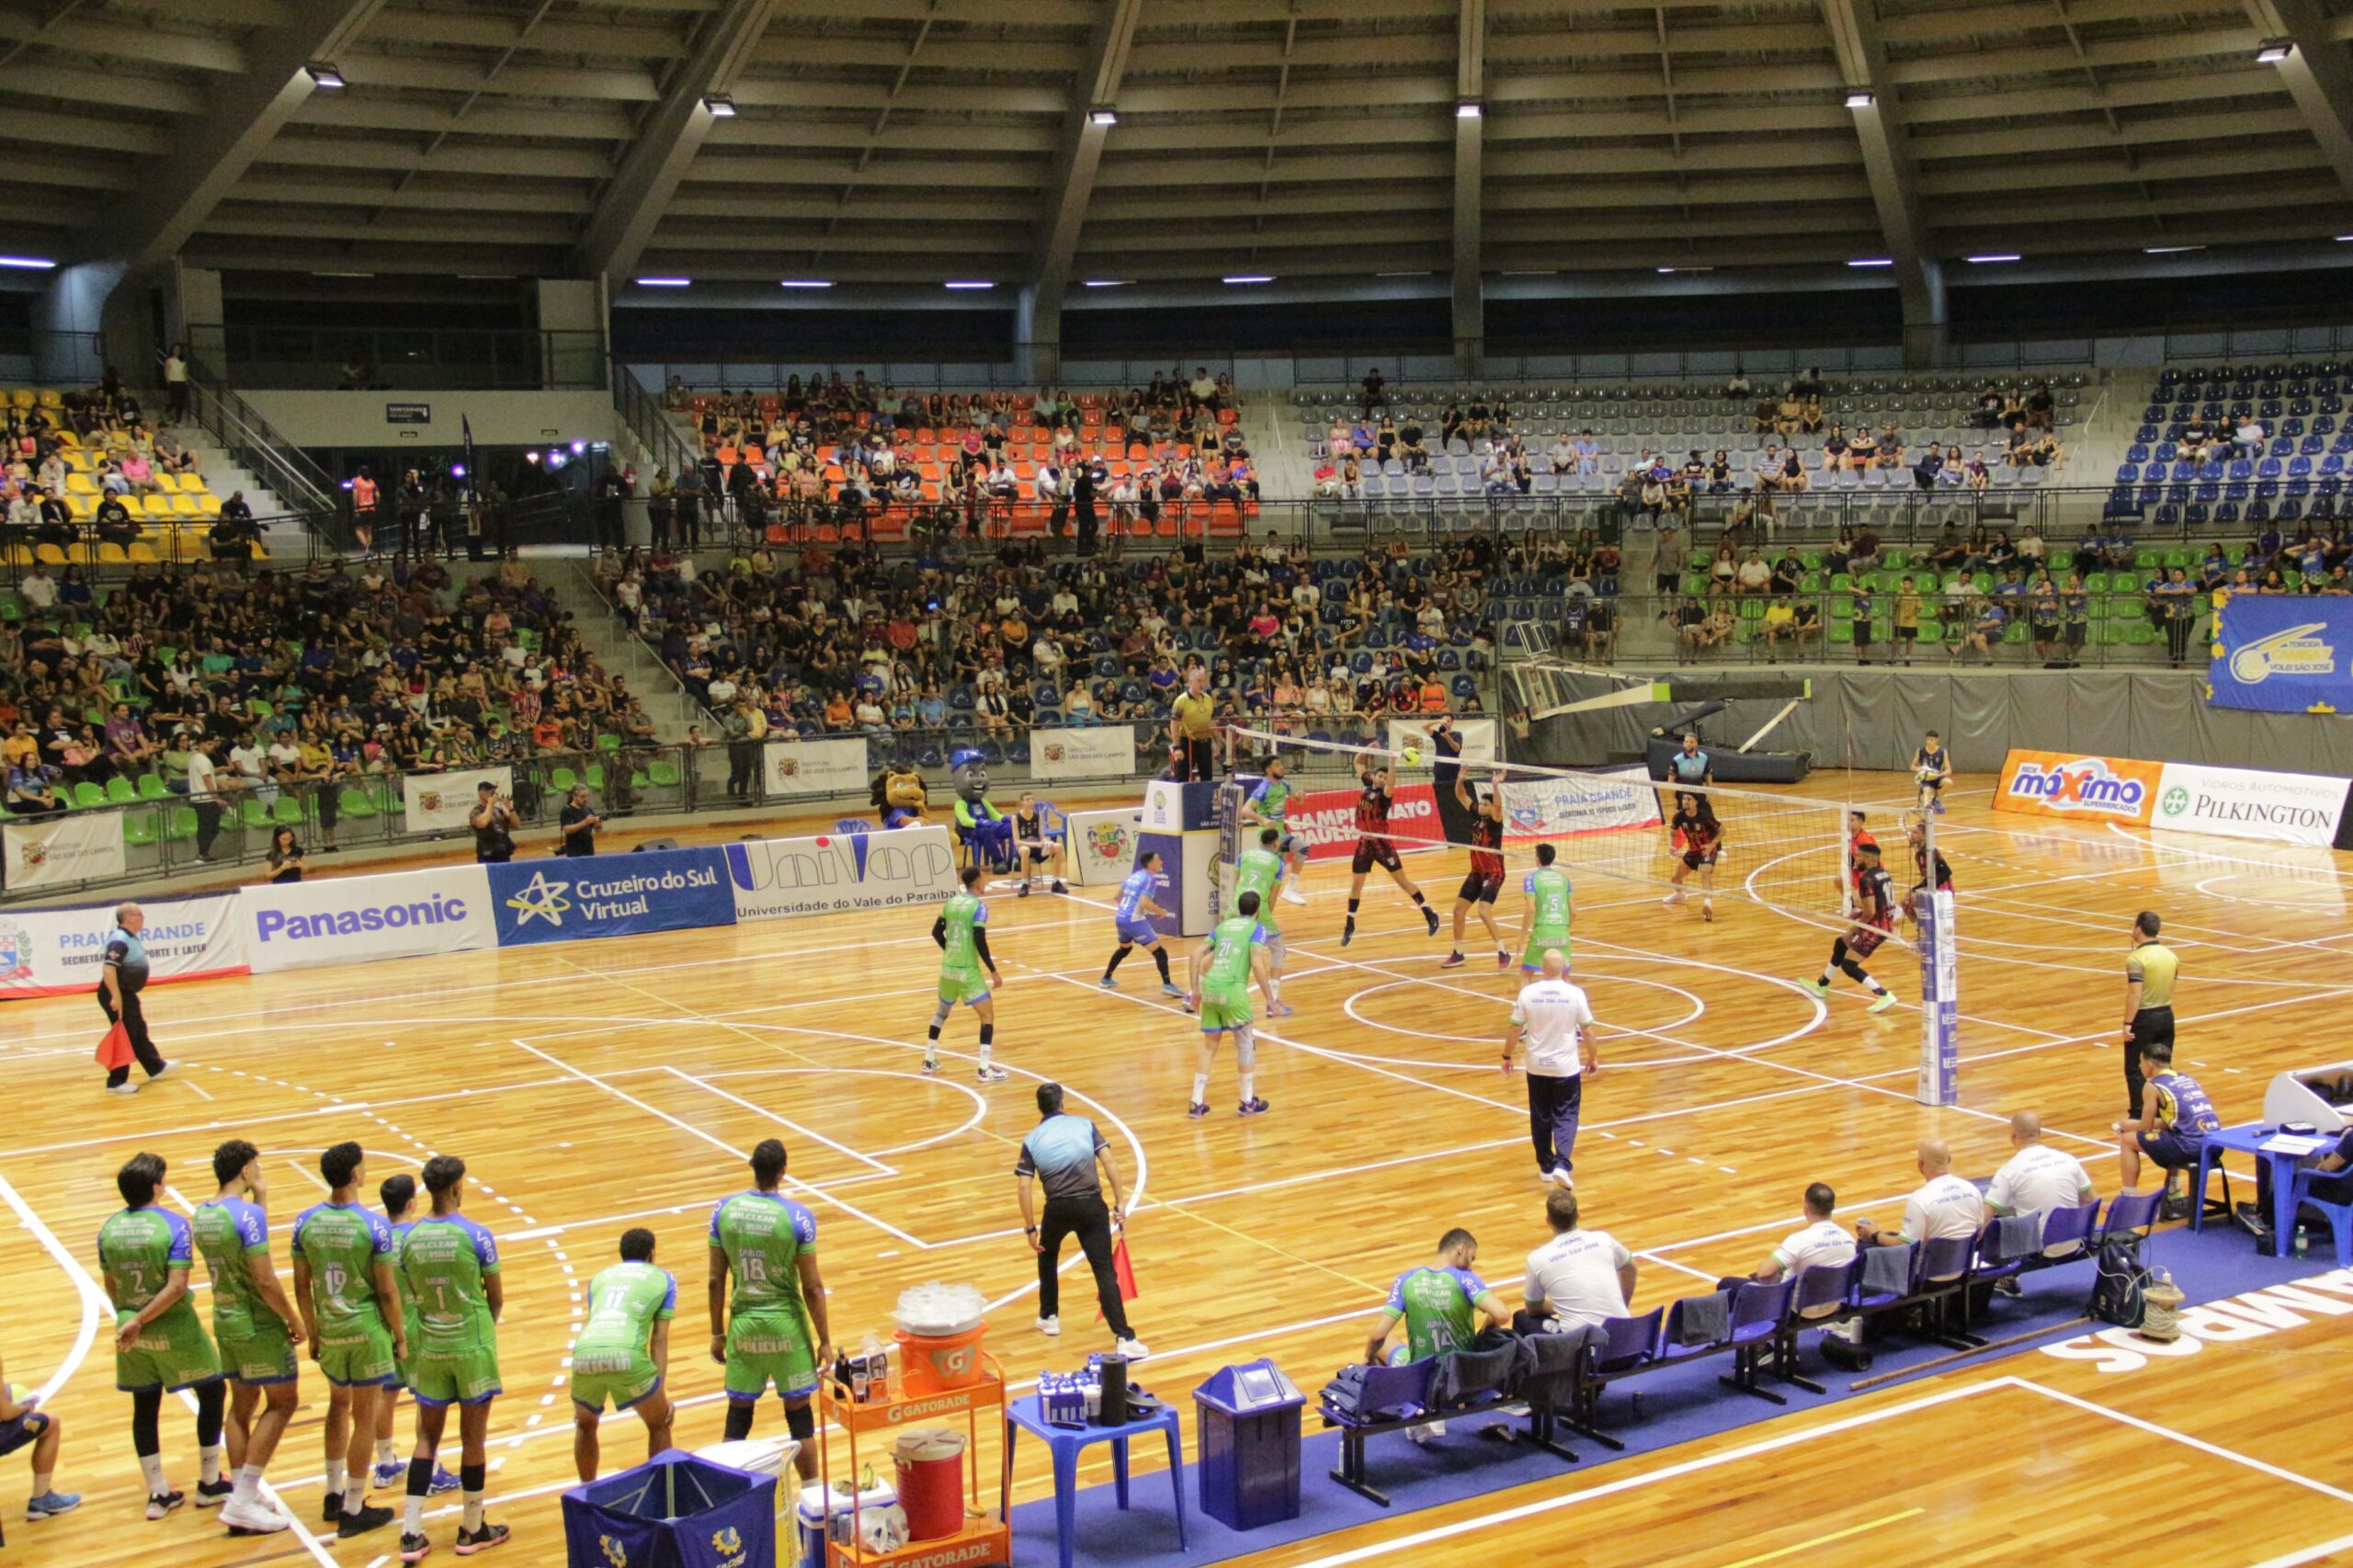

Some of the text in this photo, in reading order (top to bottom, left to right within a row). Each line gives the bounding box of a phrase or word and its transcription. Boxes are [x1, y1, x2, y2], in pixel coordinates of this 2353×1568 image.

[2021, 765, 2039, 774] REDE
[1554, 787, 1632, 806] PRAIA GRANDE
[2201, 779, 2340, 801] VIDROS AUTOMOTIVOS
[2084, 799, 2138, 814] SUPERMERCADOS
[575, 866, 718, 899] Cruzeiro do Sul
[256, 892, 468, 942] Panasonic
[579, 894, 650, 921] Virtual
[736, 901, 828, 918] Universidade
[833, 898, 850, 909] do
[853, 894, 882, 908] Vale
[886, 893, 904, 904] do
[1551, 898, 1559, 912] 5
[143, 922, 206, 942] RANDE
[728, 1211, 778, 1223] MILCLEAN
[410, 1240, 459, 1251] MILCLEAN
[476, 1230, 494, 1263] vero
[740, 1256, 767, 1281] 18
[130, 1269, 147, 1294] 2
[324, 1269, 347, 1295] 19
[436, 1286, 445, 1310] 1
[605, 1290, 625, 1309] 11
[1431, 1328, 1457, 1353] 14
[947, 1351, 963, 1370] G
[904, 1393, 971, 1417] GATORADE
